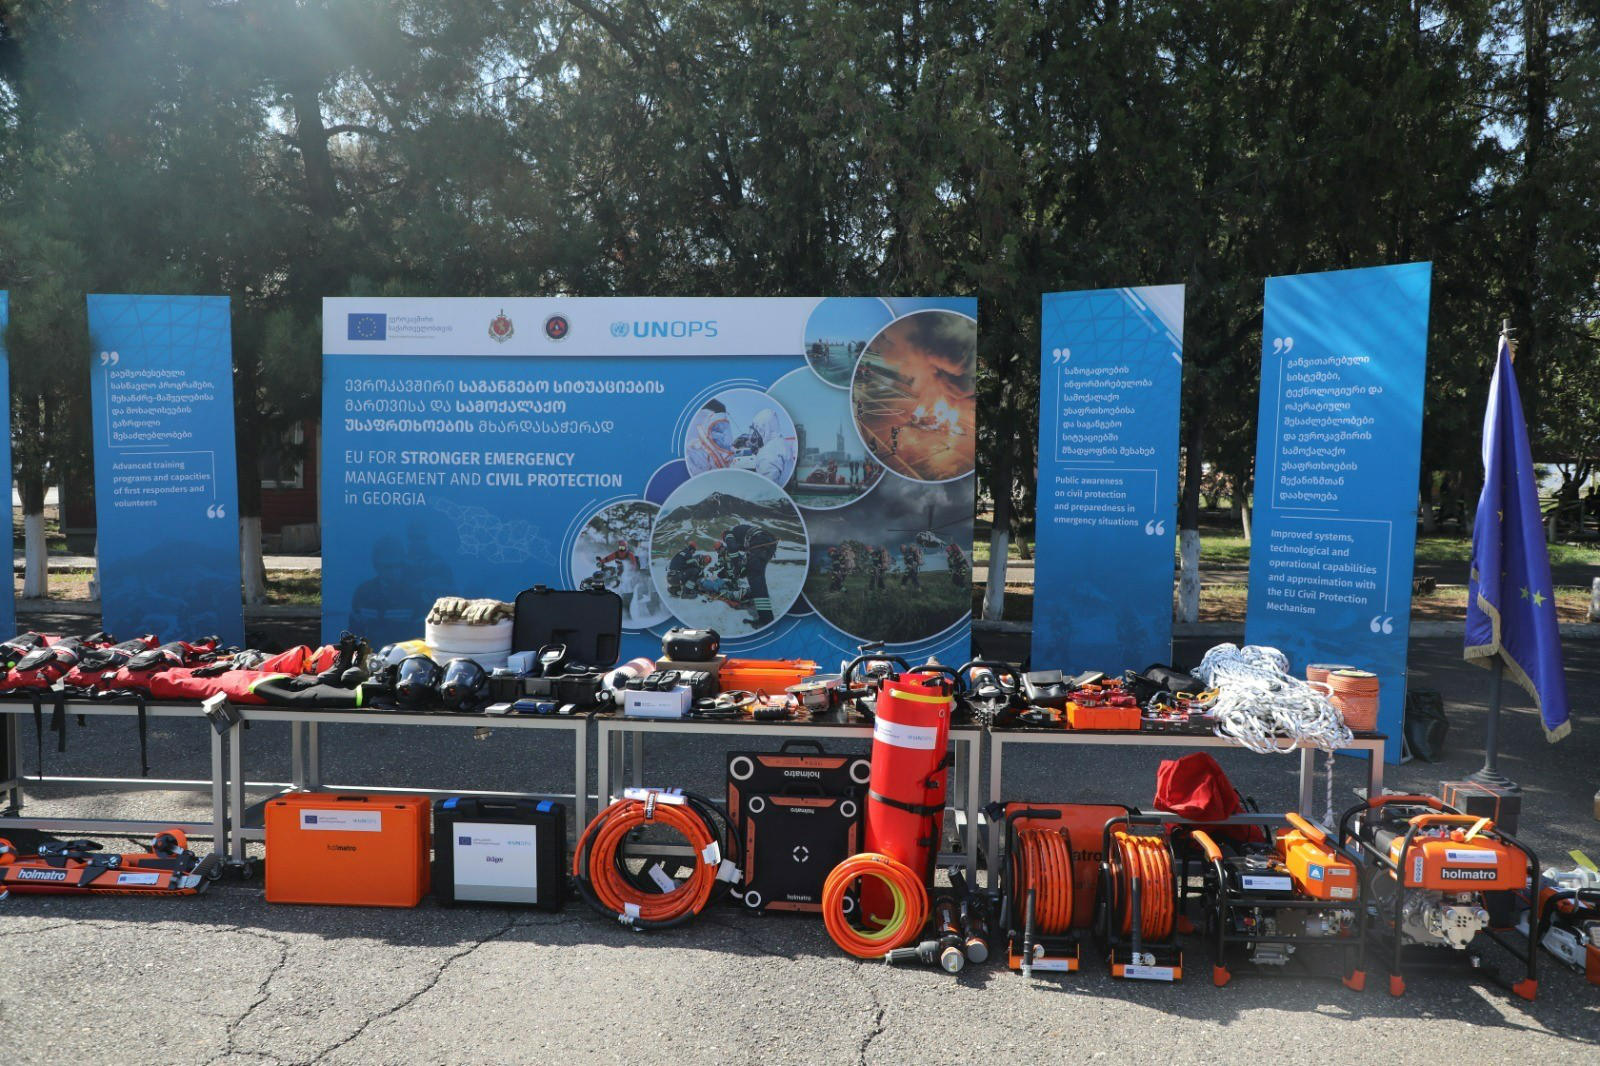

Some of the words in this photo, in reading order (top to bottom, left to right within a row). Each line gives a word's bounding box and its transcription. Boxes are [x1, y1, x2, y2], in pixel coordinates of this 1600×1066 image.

[633, 321, 718, 337] UNOPS
[1287, 356, 1370, 368] განვითარებული
[345, 379, 455, 392] ევროკავშირი
[459, 380, 549, 393] საგანგებო
[553, 380, 665, 393] სიტუაციების
[1368, 386, 1383, 394] და
[345, 399, 425, 412] მართვისა
[430, 400, 451, 412] და
[456, 400, 566, 413] სამოქალაქო
[112, 408, 125, 416] და
[345, 418, 474, 432] უსაფრთხოების
[478, 420, 614, 433] მხარდასაჭერად
[1283, 433, 1296, 441] და
[1298, 431, 1372, 442] ევროკავშირის
[1282, 446, 1346, 456] სამოქალაქო
[345, 451, 363, 463] EU
[369, 451, 397, 464] FOR
[401, 451, 480, 465] STRONGER
[484, 452, 575, 466] EMERGENCY
[112, 462, 151, 470] Advanced
[153, 461, 185, 470] training
[113, 475, 152, 483] programs
[170, 473, 211, 481] capacities
[345, 471, 447, 485] MANAGEMENT
[450, 473, 481, 485] AND
[486, 473, 524, 486] CIVIL
[527, 474, 623, 487] PROTECTION
[143, 486, 187, 494] responders
[1084, 491, 1127, 499] protection
[345, 491, 358, 504] in
[362, 492, 427, 505] GEORGIA
[1071, 504, 1126, 512] preparedness
[1054, 517, 1097, 525] emergency
[1098, 517, 1139, 526] situations
[1271, 530, 1313, 539] Improved
[1314, 534, 1354, 543] systems,
[1270, 545, 1330, 556] technological
[1269, 560, 1320, 568] operational
[1322, 564, 1377, 574] capabilities
[1268, 573, 1285, 582] and
[1287, 576, 1353, 587] approximation
[1355, 580, 1376, 589] with
[1267, 588, 1282, 596] the
[1284, 589, 1296, 597] EU
[1297, 590, 1317, 599] Civil
[1319, 592, 1368, 604] Protection
[1266, 602, 1316, 614] Mechanism
[18, 869, 66, 880] holmatro
[1442, 869, 1496, 879] holmatro
